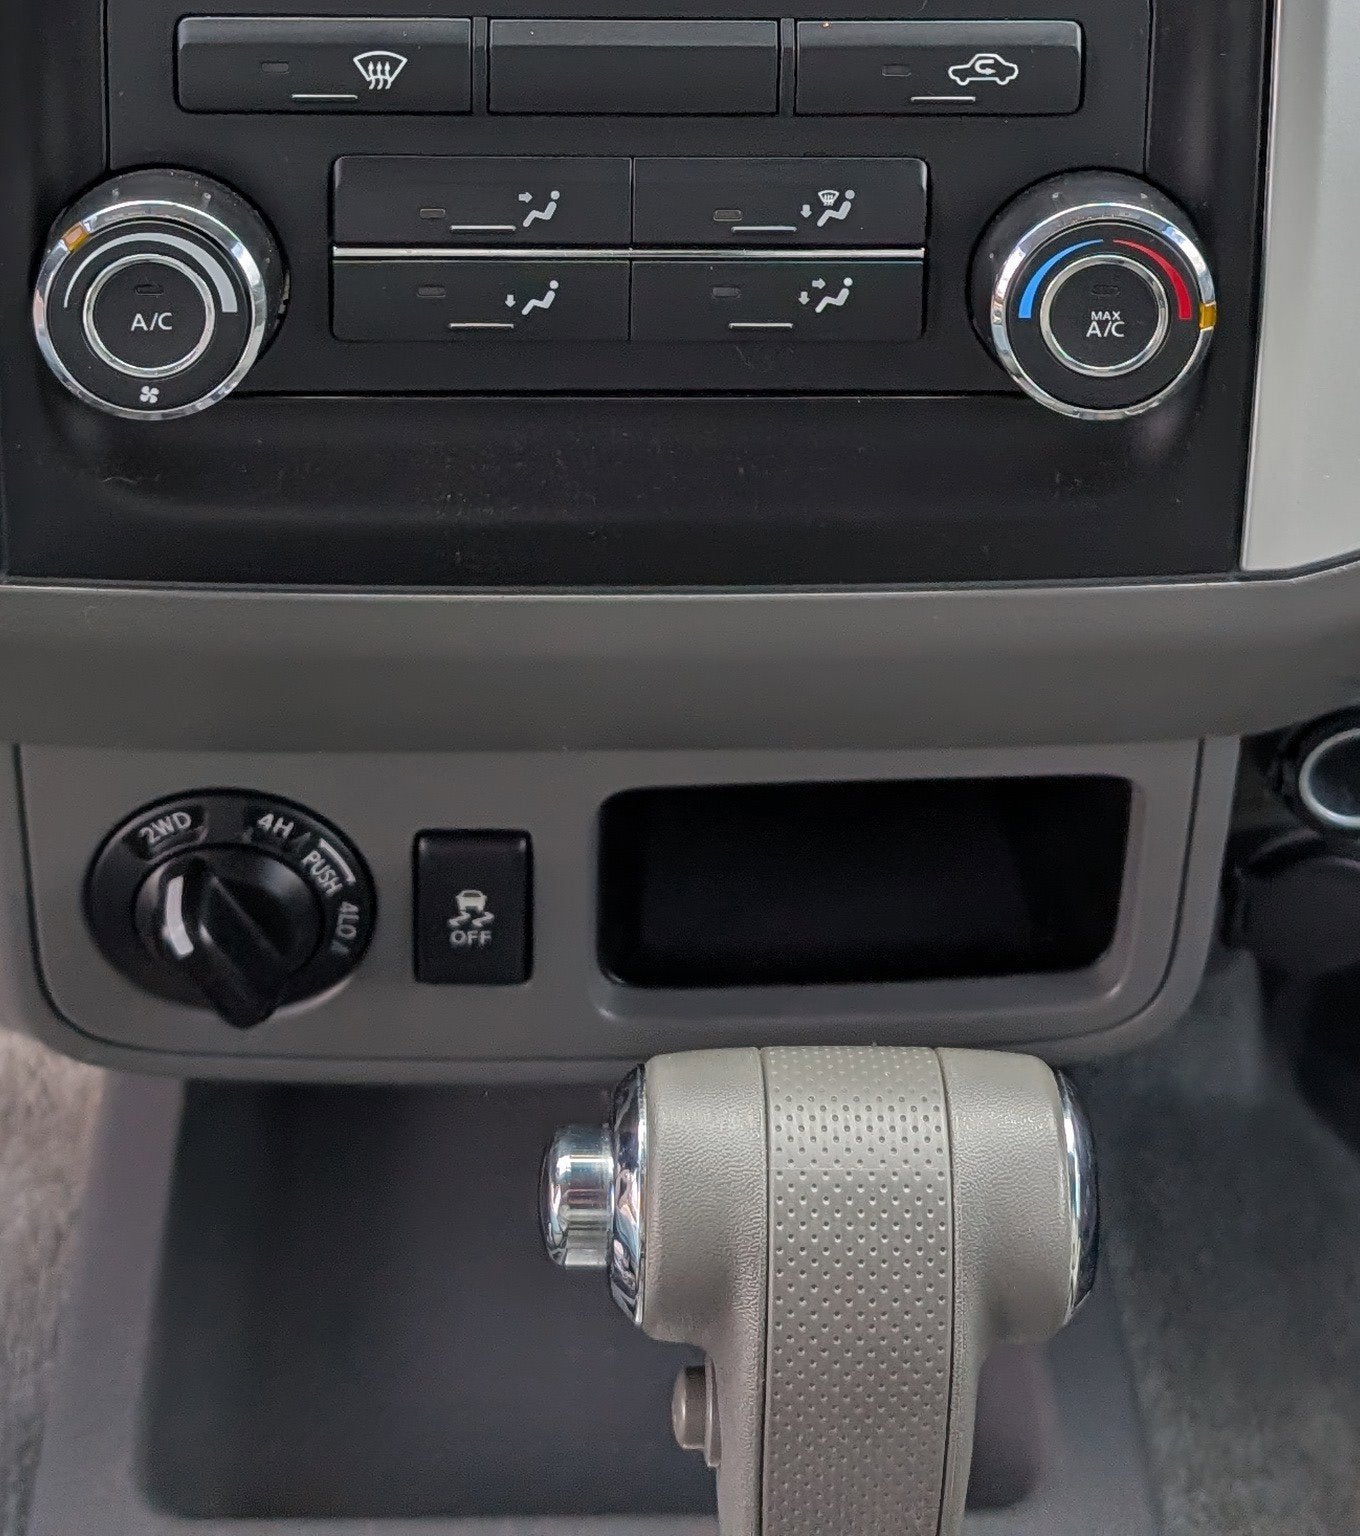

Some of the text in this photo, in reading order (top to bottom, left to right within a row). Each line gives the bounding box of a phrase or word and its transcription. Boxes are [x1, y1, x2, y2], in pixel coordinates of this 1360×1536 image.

[130, 312, 174, 332] A/C
[1090, 310, 1122, 321] MAX
[1085, 321, 1126, 338] A/C
[139, 810, 192, 845] 2WD
[256, 812, 295, 840] 4H
[302, 849, 343, 899] PUSH
[335, 900, 360, 941] 4LO
[448, 929, 492, 947] OFF
